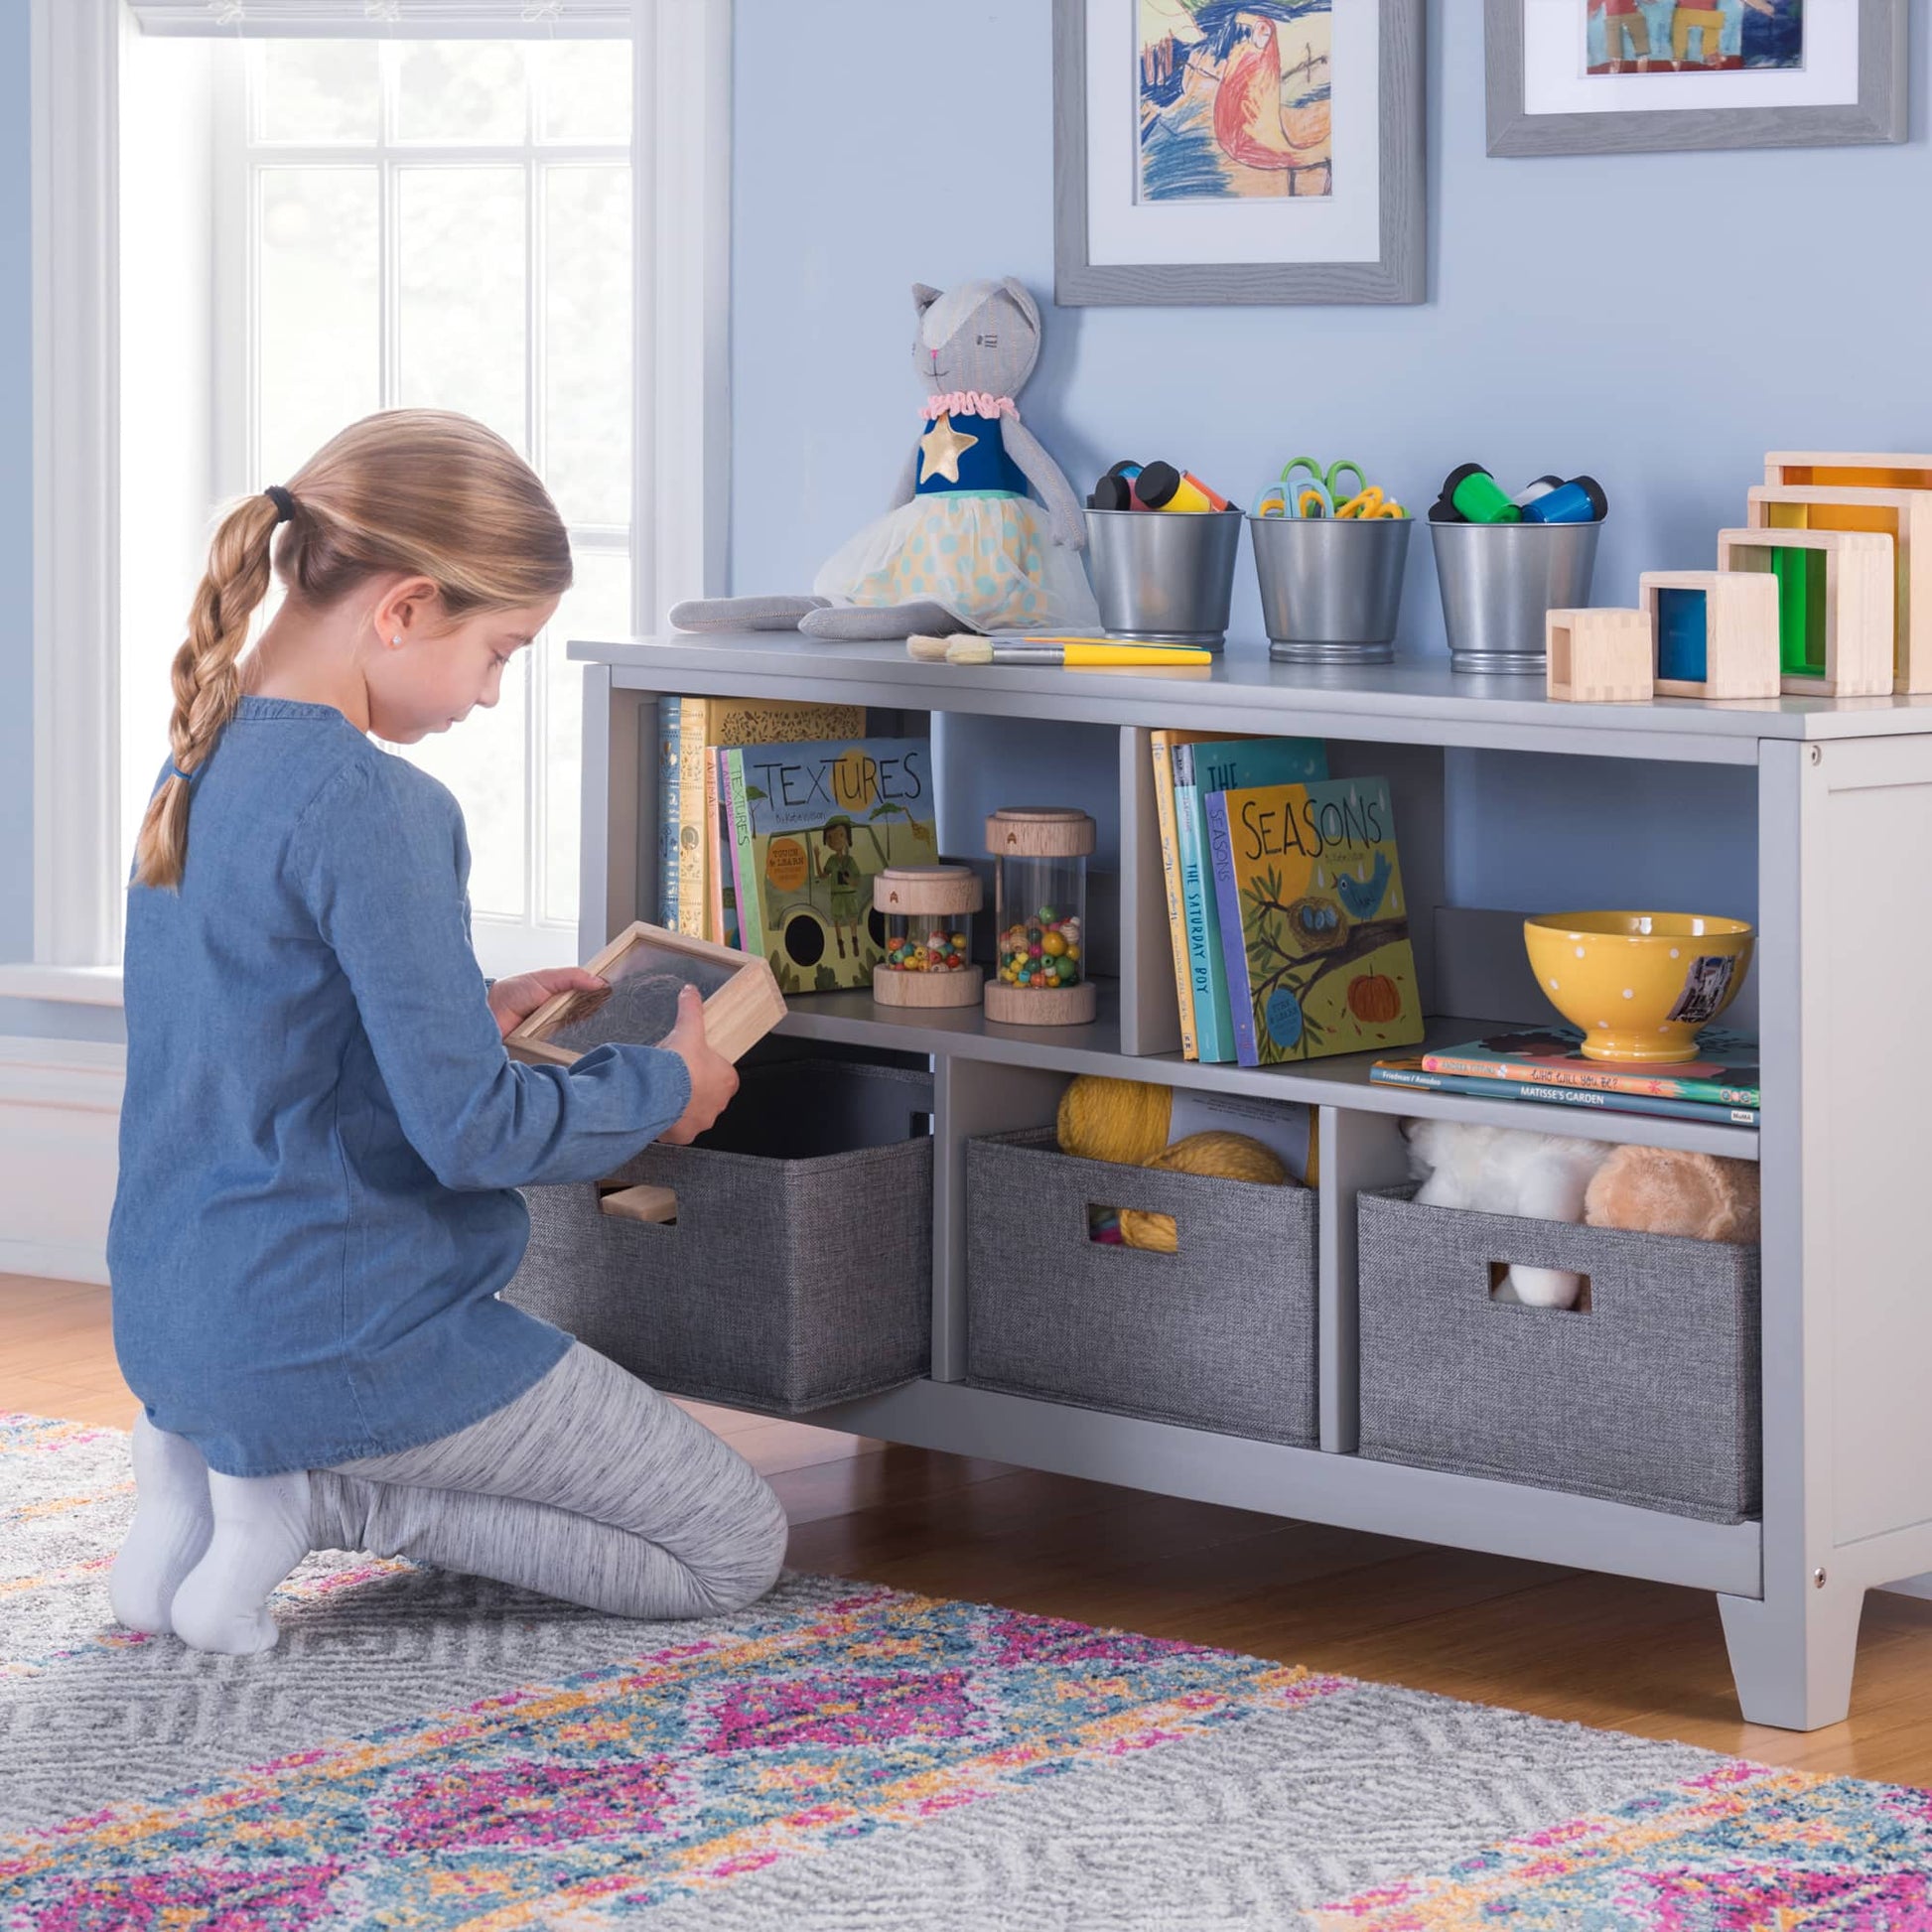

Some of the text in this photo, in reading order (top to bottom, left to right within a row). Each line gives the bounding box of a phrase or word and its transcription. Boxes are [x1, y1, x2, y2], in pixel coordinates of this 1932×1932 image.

[731, 764, 751, 847] TEXTURES
[753, 752, 921, 811] TEXTURES
[1209, 809, 1231, 883] SEASONS
[1242, 795, 1382, 861] SEASONS
[1185, 864, 1208, 994] THE SATURDAY BOY
[1520, 1086, 1605, 1105] MATISSE'S GARDEN
[1556, 1072, 1576, 1085] WILL
